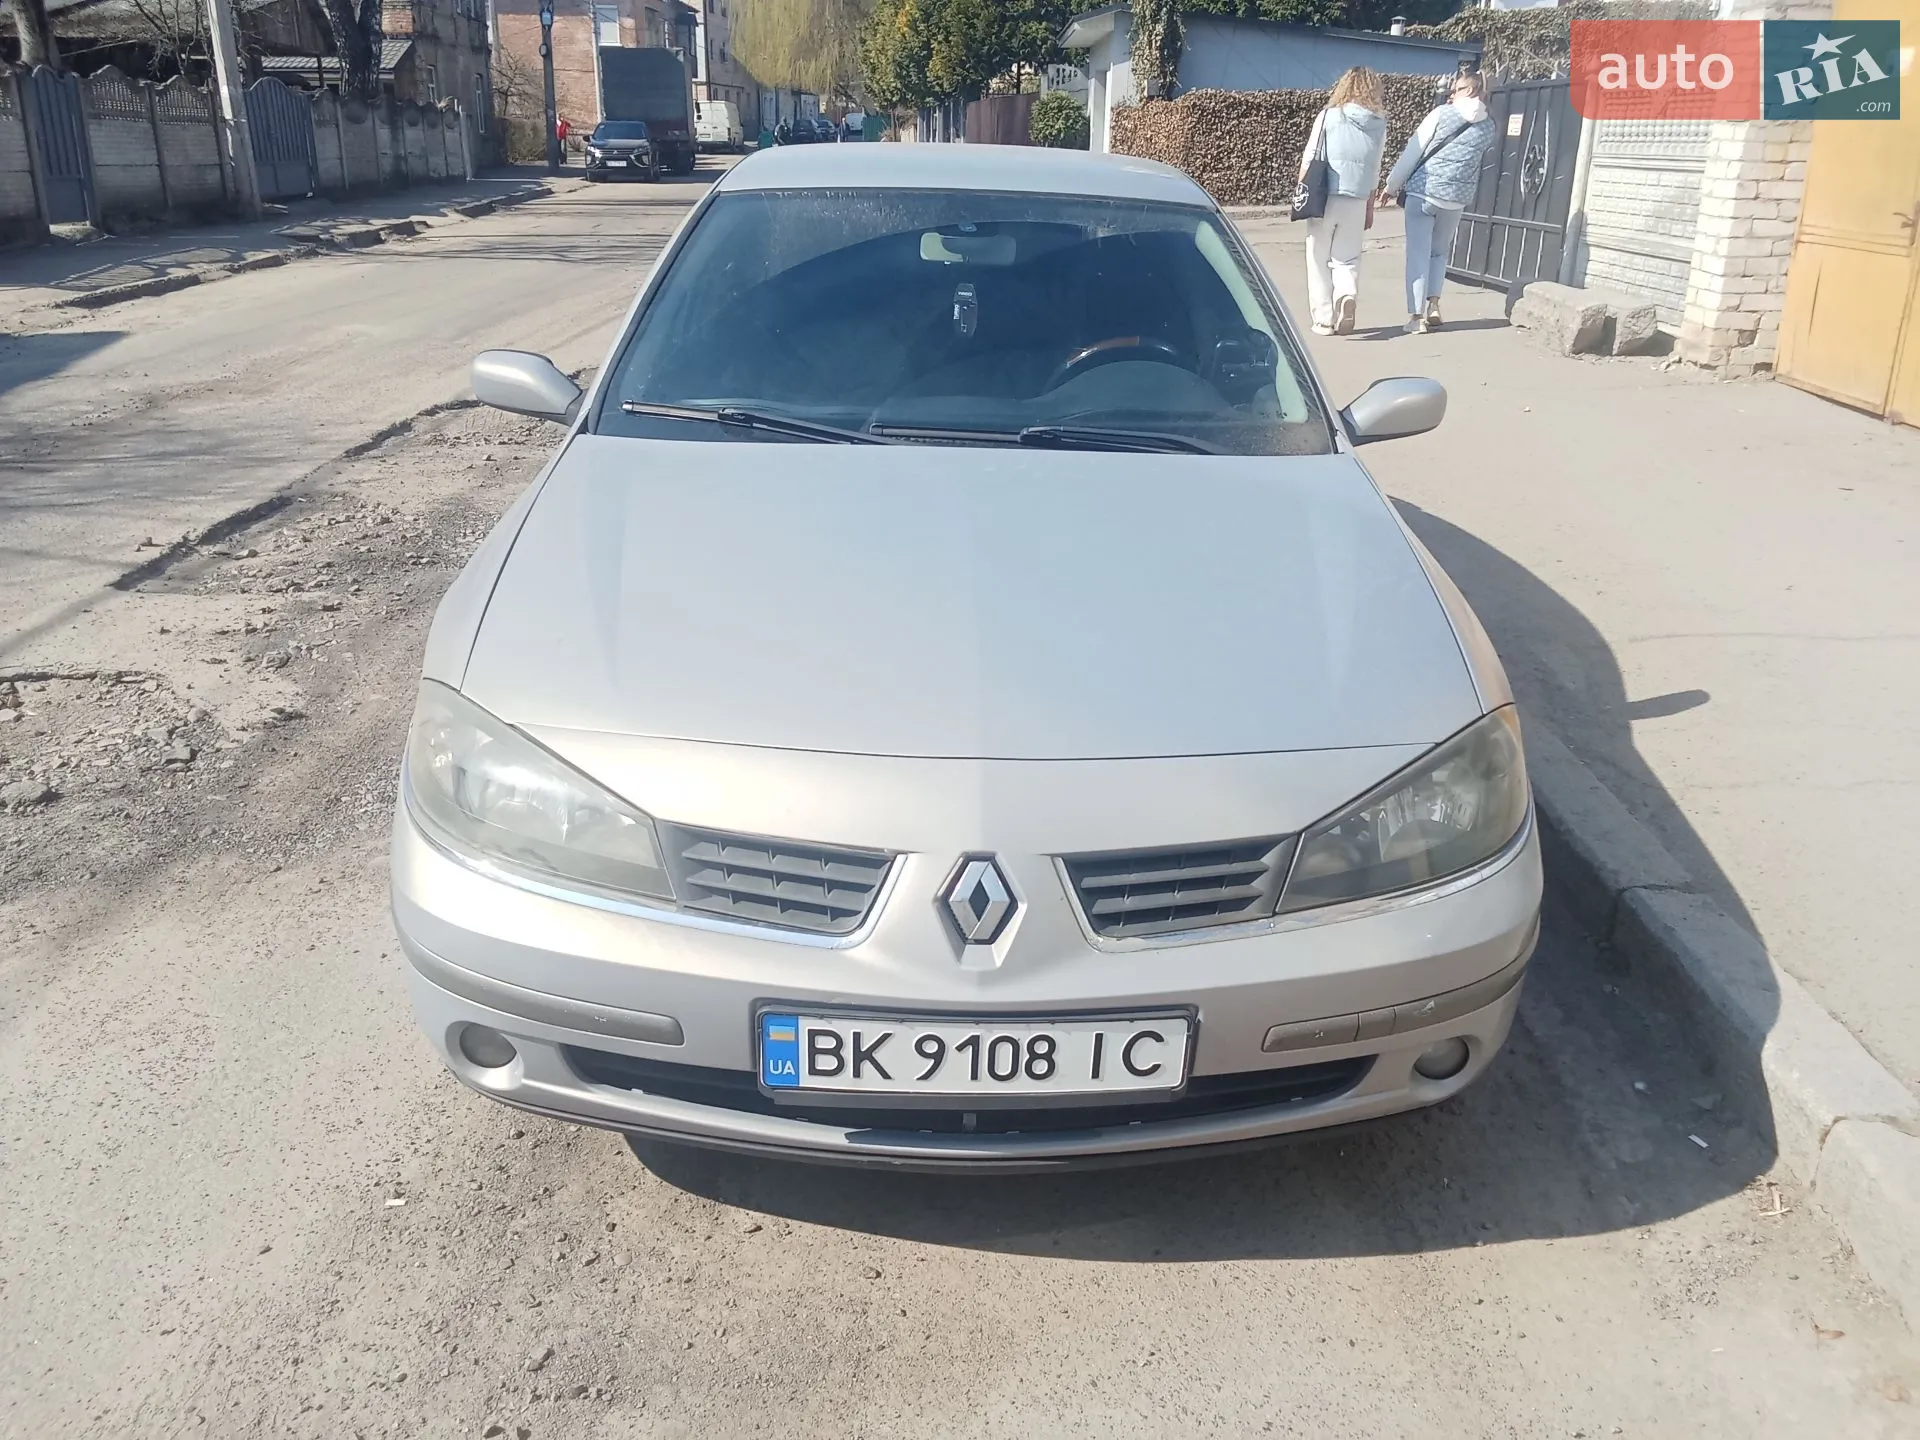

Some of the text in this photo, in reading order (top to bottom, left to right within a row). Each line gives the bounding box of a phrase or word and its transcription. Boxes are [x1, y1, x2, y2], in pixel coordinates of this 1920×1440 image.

[769, 1059, 796, 1076] UA
[807, 1028, 1165, 1082] BK 9108 IC
